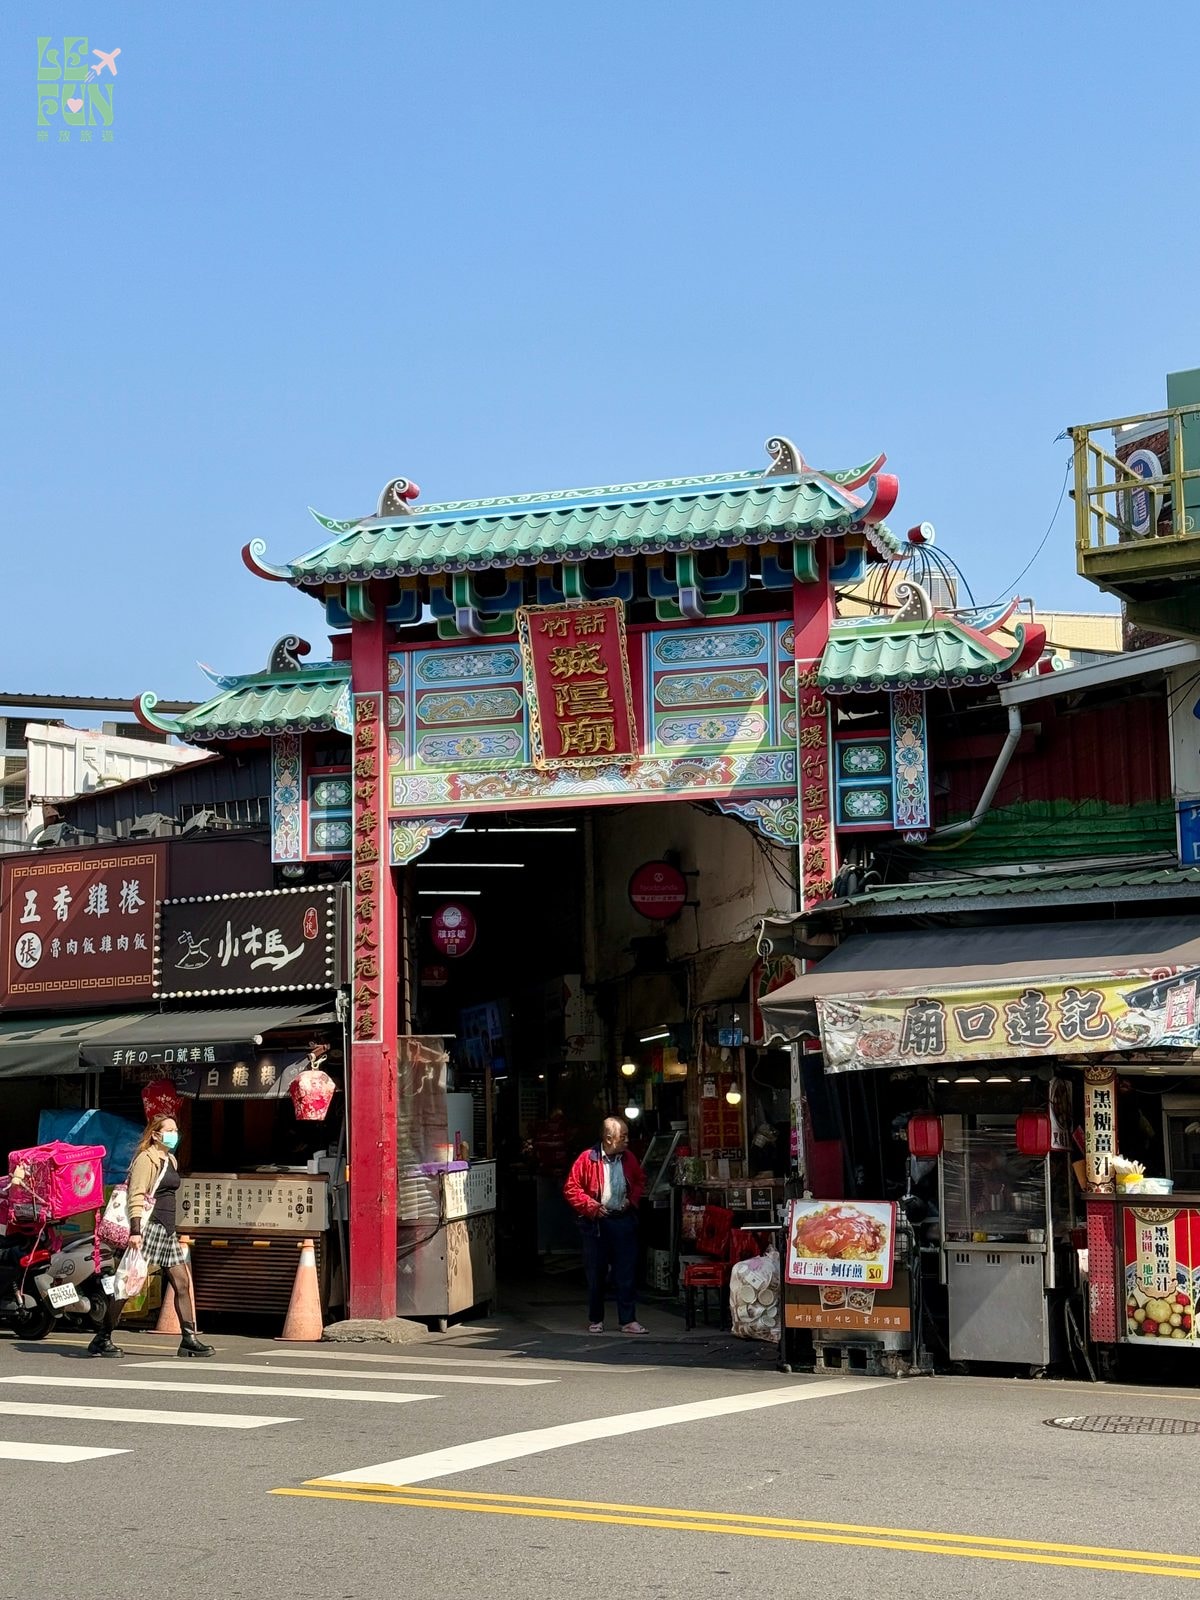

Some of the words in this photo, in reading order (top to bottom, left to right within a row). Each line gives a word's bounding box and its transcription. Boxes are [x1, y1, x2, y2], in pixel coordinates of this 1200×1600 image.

[549, 640, 616, 756] 城隍廟
[20, 879, 145, 924] 五香雞捲
[20, 936, 38, 964] 張
[50, 933, 148, 959] 魯肉飯雞肉飯
[217, 920, 305, 972] 小木馬
[901, 989, 1112, 1056] 廟口連記
[112, 1046, 215, 1065] 手作の一口就幸福
[207, 1065, 276, 1087] 白糖粿
[1093, 1089, 1112, 1176] 黑糖薑汁
[1154, 1226, 1170, 1292] 黑糖薑汁
